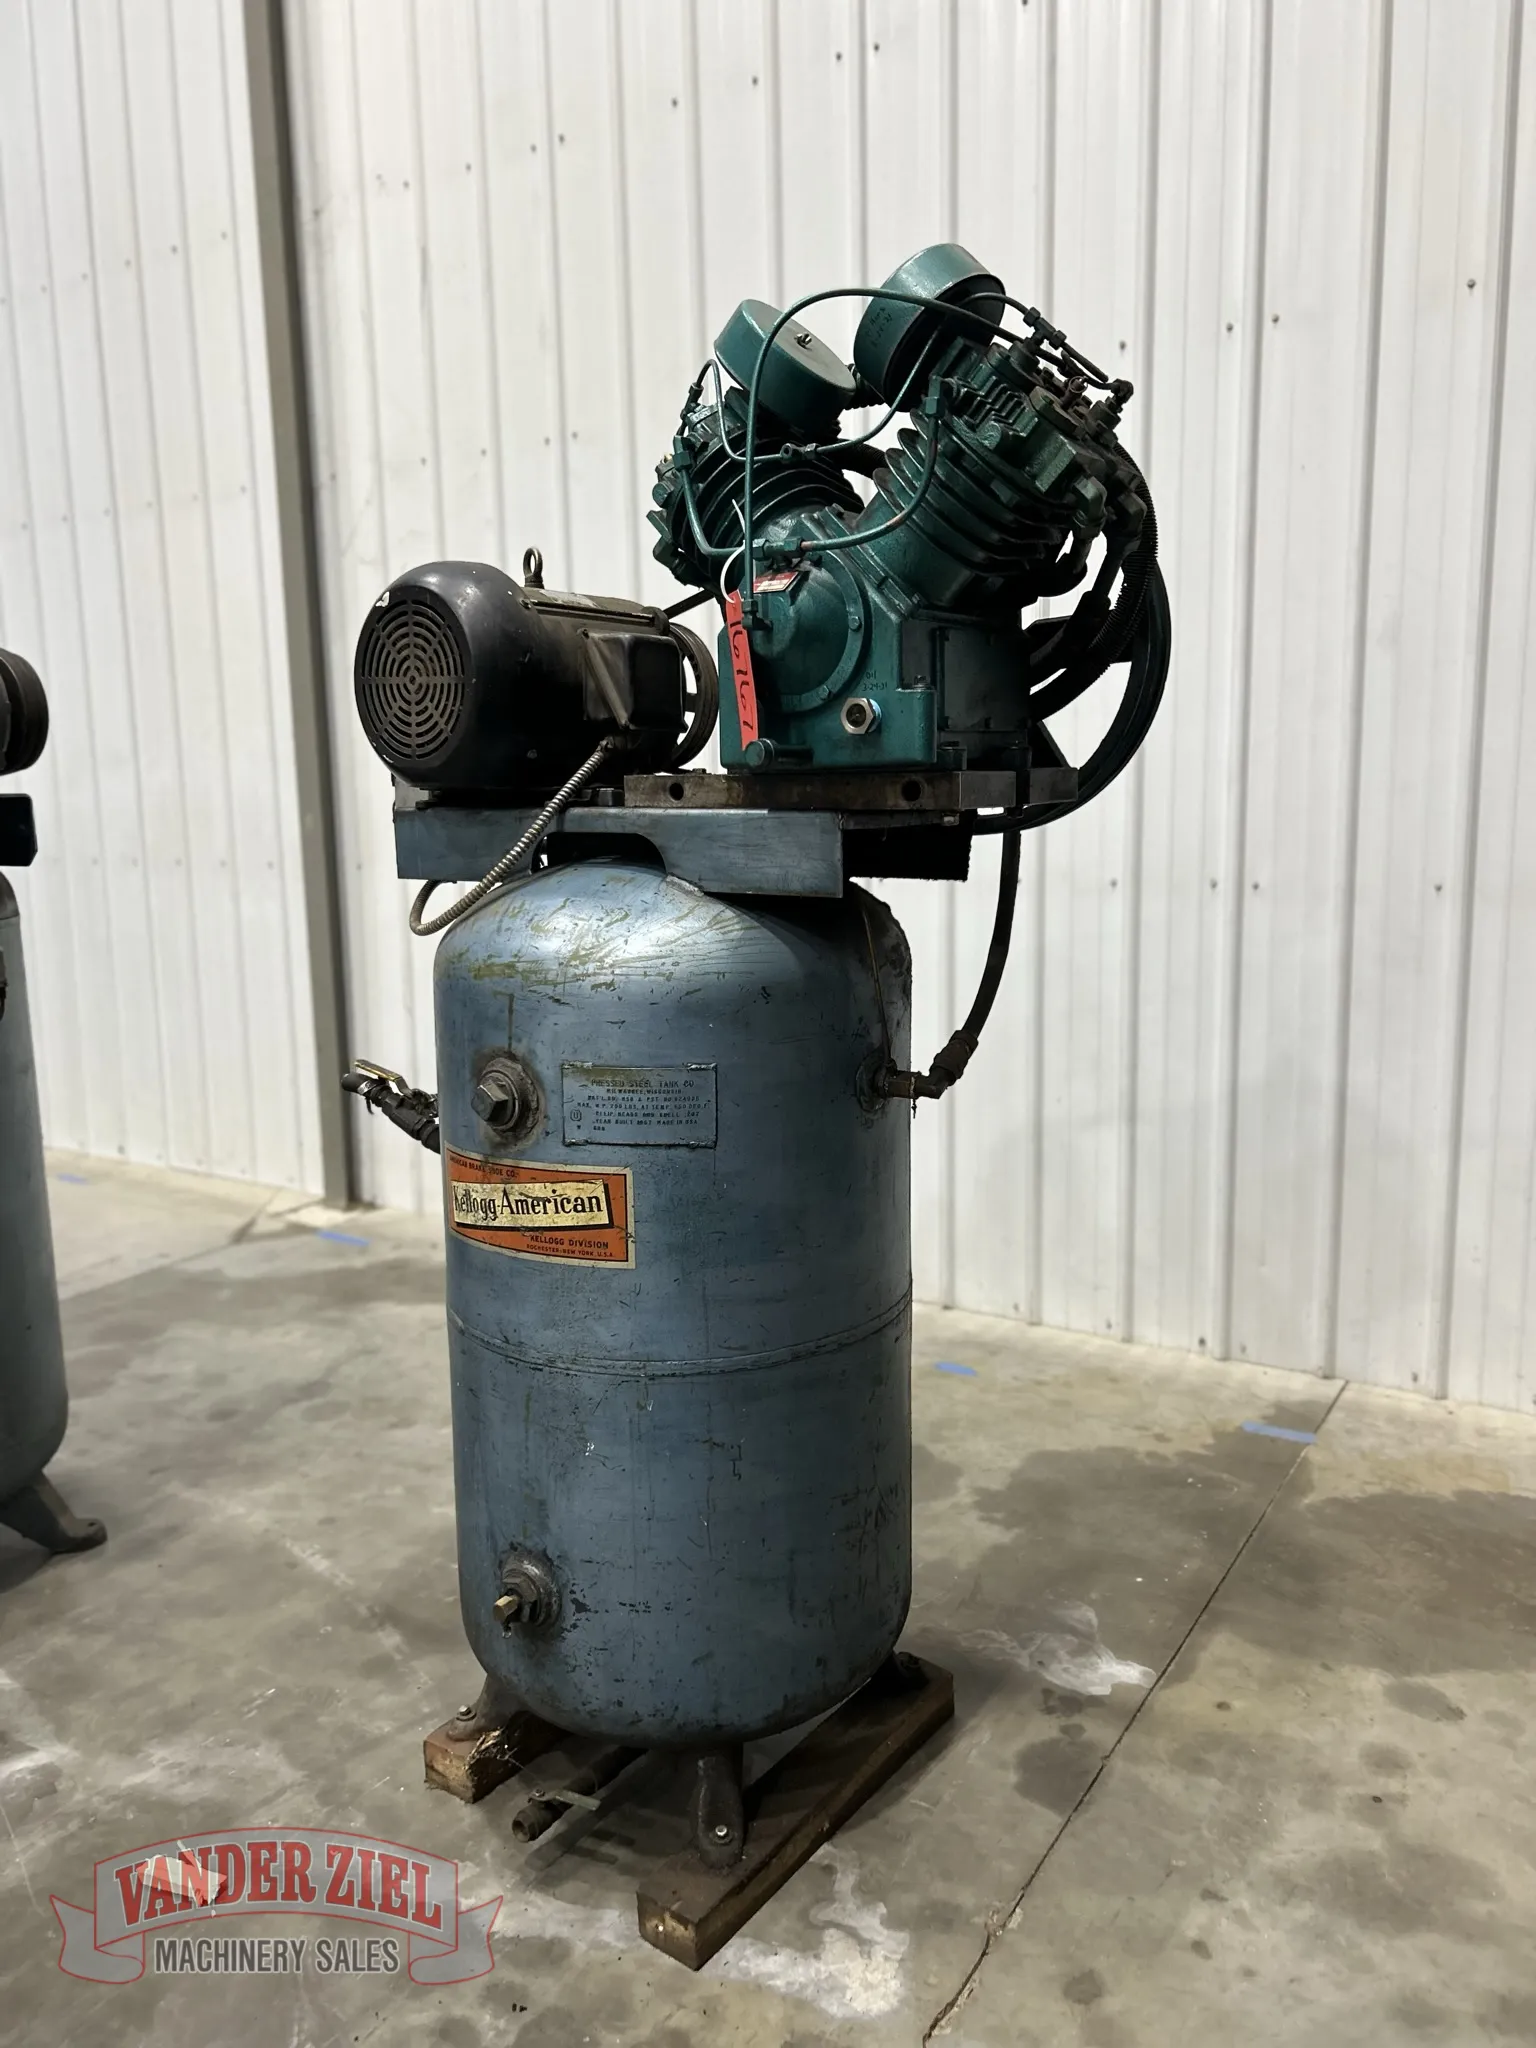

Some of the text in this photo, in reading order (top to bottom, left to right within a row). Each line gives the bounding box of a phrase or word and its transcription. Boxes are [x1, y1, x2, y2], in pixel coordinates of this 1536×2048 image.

[591, 1079, 625, 1088] PRESSED
[628, 1080, 652, 1088] STEEL
[659, 1080, 680, 1088] TANK
[530, 1235, 608, 1249] KELLOGG DIVISION
